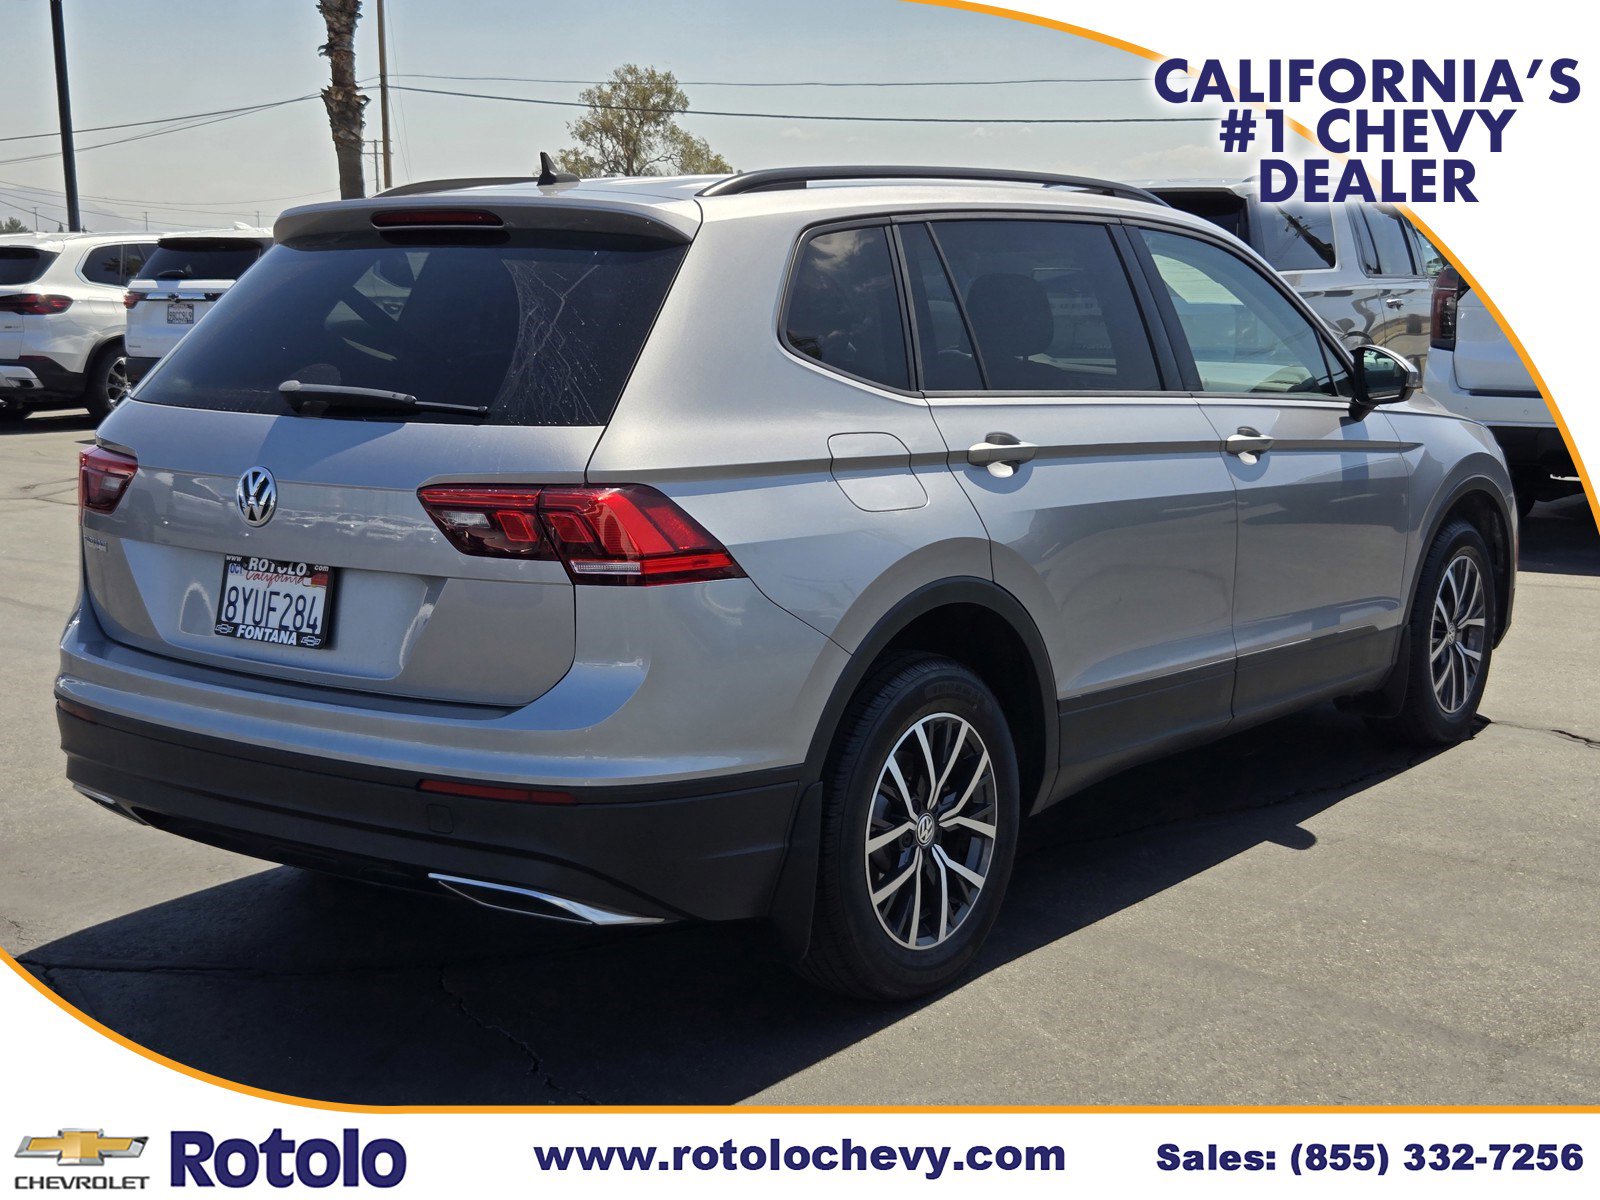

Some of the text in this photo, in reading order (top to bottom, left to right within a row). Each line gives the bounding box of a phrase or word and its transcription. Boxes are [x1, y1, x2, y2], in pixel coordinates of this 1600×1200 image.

[248, 557, 307, 576] ROTOLO
[314, 564, 329, 572] com
[224, 586, 318, 634] 8YUF284
[236, 624, 297, 645] FONTANA
